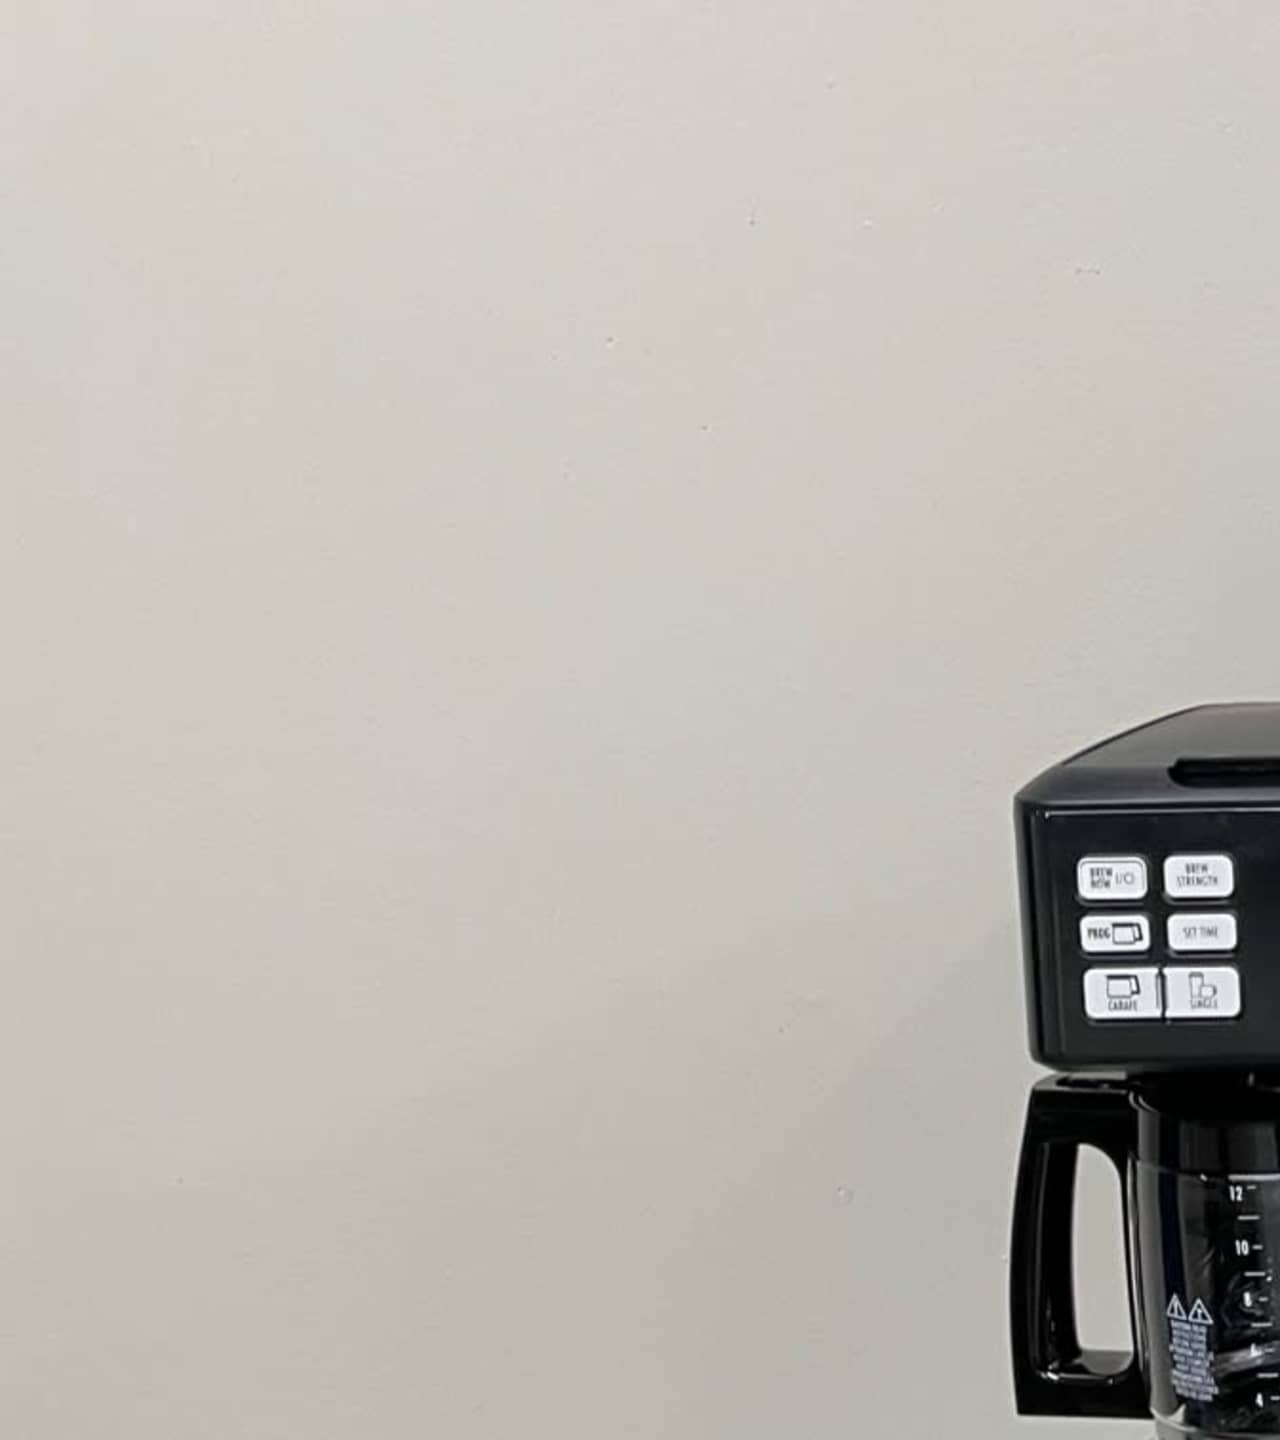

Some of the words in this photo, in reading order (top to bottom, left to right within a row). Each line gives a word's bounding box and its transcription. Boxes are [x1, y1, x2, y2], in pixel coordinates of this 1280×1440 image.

[1090, 867, 1113, 877] BREW
[1185, 863, 1209, 873] BREW
[1177, 875, 1219, 887] STRENGTH
[1183, 927, 1198, 939] SET
[1199, 926, 1218, 938] TIME
[1229, 1185, 1243, 1202] 12
[1235, 1239, 1250, 1257] 10
